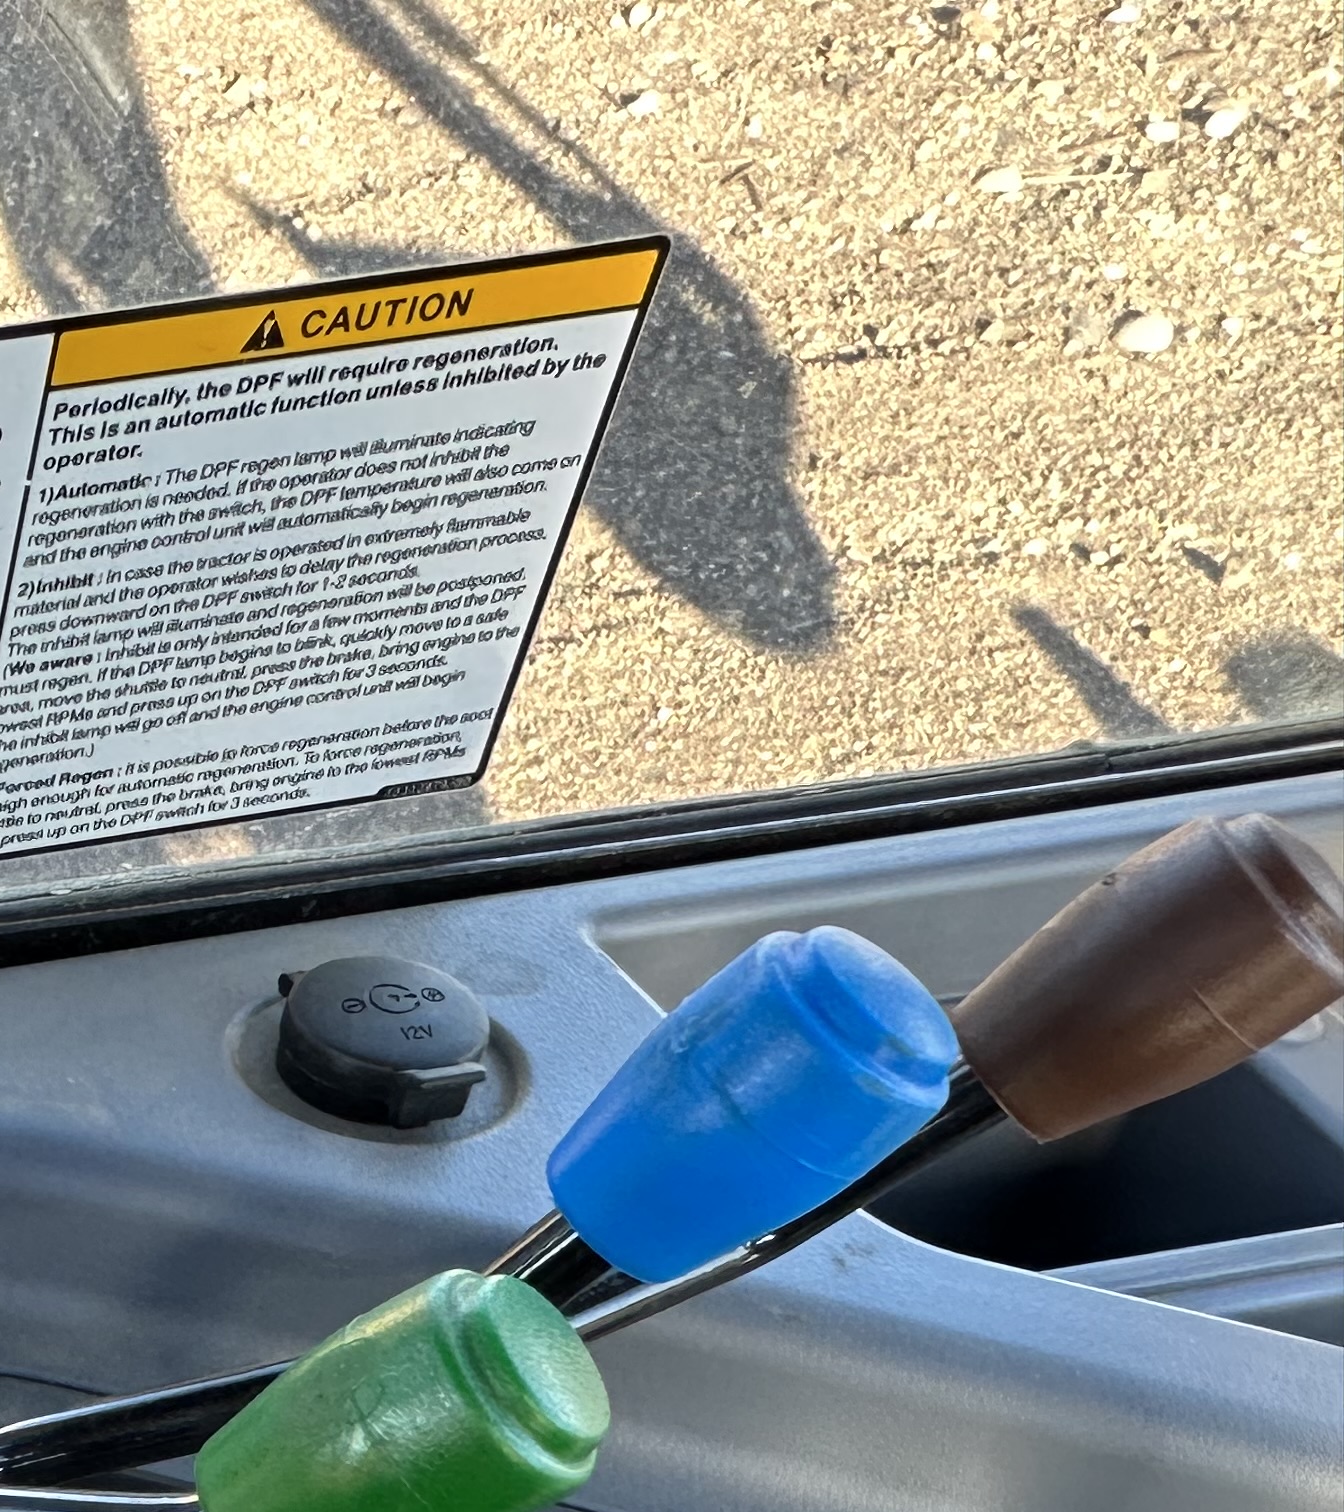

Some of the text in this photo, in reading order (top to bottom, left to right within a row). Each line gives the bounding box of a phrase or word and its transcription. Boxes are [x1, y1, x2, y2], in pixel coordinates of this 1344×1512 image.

[300, 287, 475, 339] CAUTION
[48, 351, 607, 447] This is an automatic function unless inhibited by the
[52, 336, 559, 422] Periodically, the DPF will require regeneration.
[42, 444, 143, 474] operator.
[400, 1024, 433, 1041] 12V
